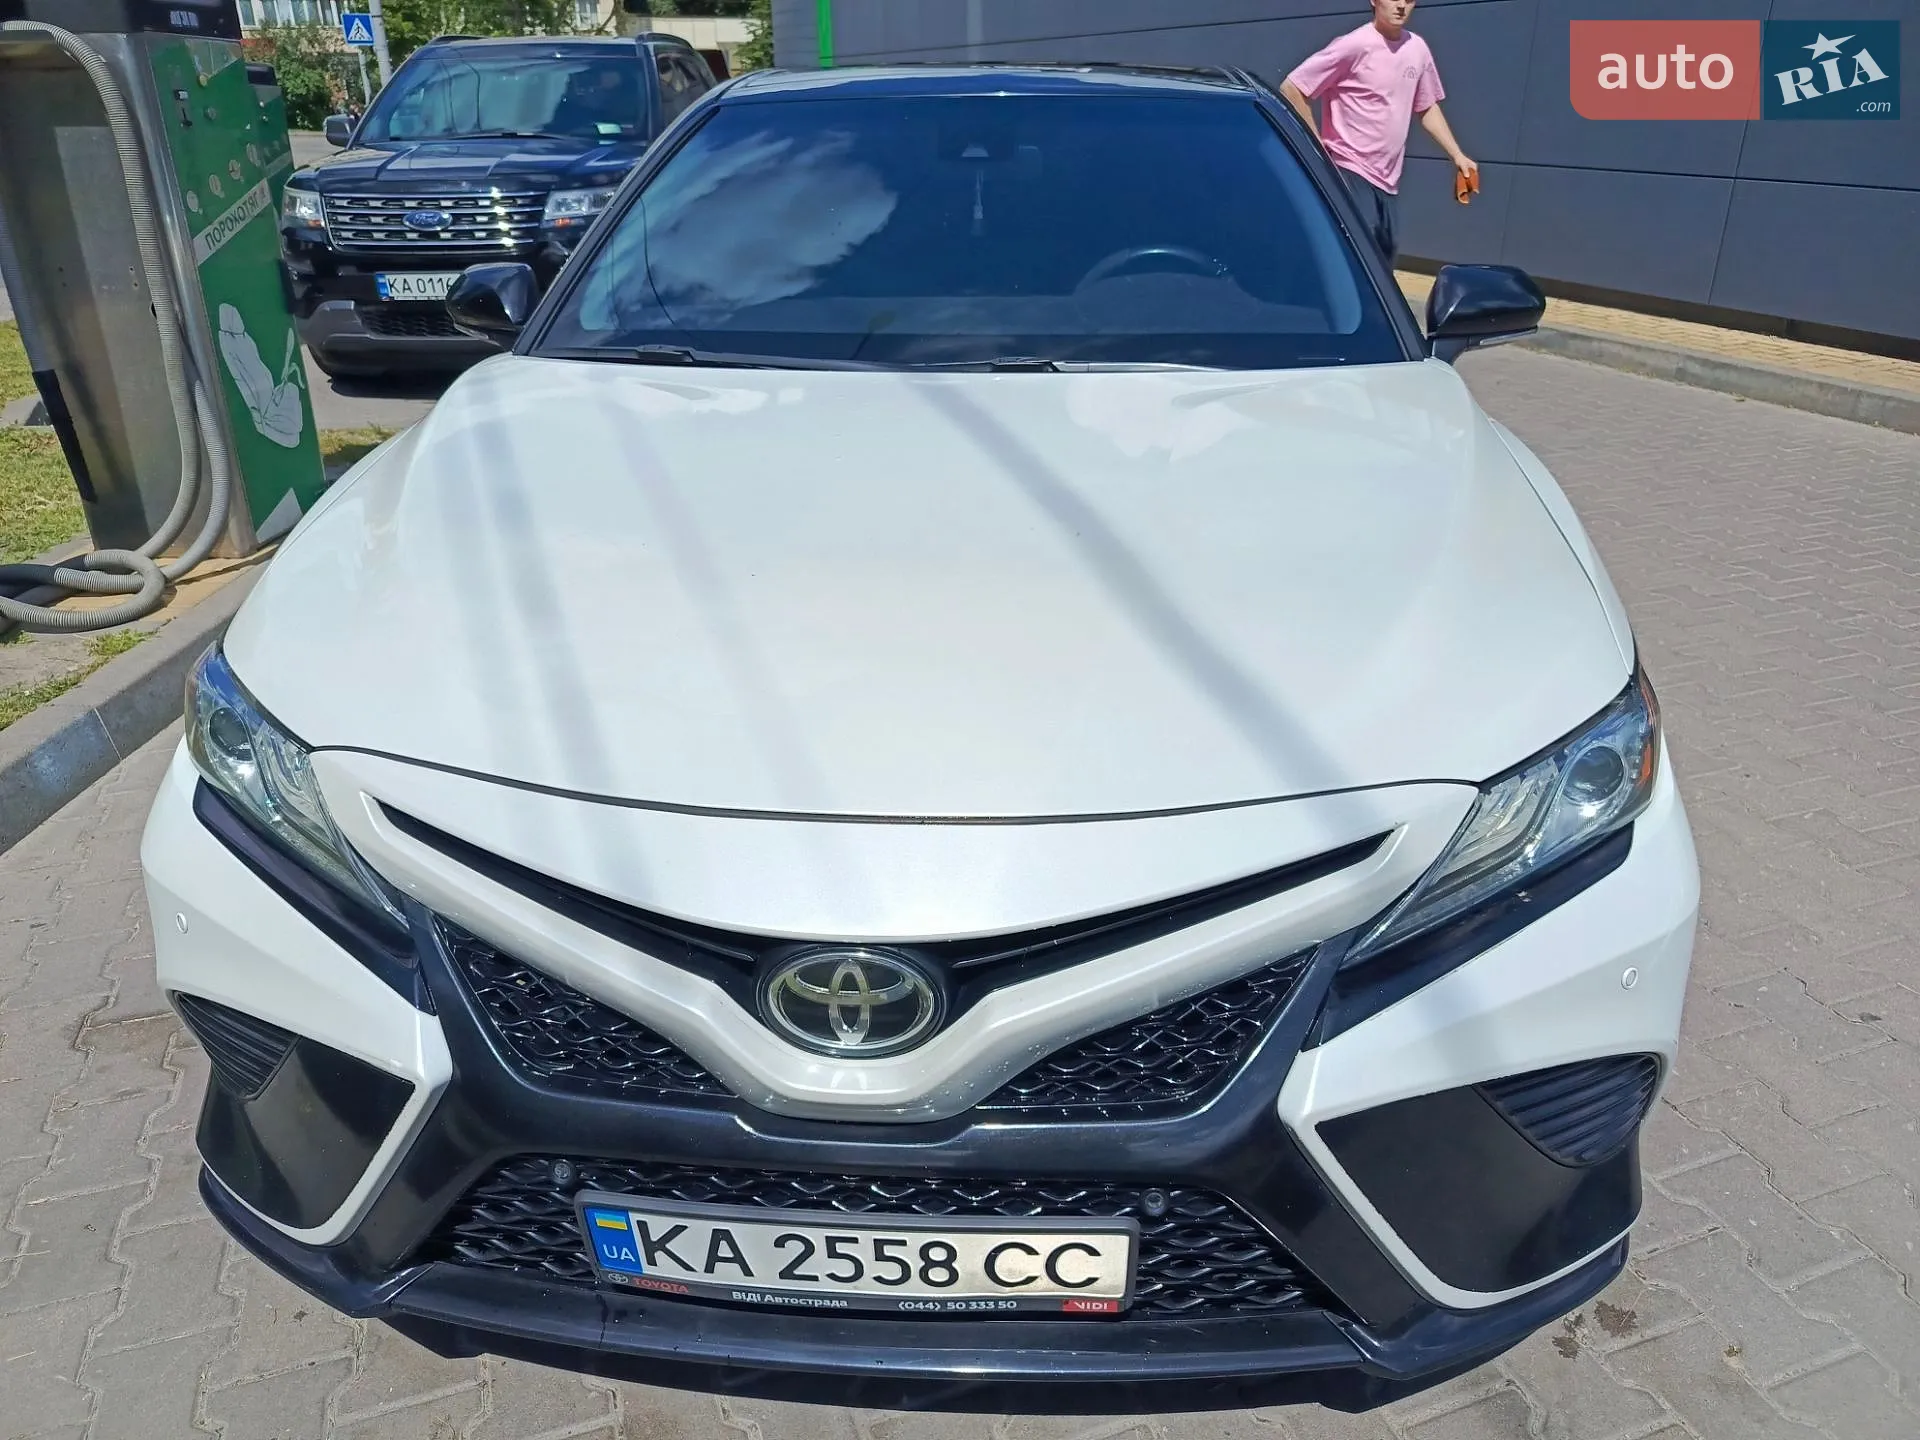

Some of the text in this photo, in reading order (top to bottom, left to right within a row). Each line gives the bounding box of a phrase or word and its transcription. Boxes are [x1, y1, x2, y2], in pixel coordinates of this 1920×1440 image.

[204, 190, 260, 251] ПОРОХОТЯГ
[387, 278, 413, 294] KA
[603, 1244, 636, 1262] UA
[636, 1219, 1102, 1288] KA 2558 CC
[632, 1277, 689, 1293] TOYOTA
[764, 1294, 848, 1308] Автострада
[899, 1301, 1017, 1311] (044) 50 333 50
[1073, 1301, 1108, 1310] VIDI
